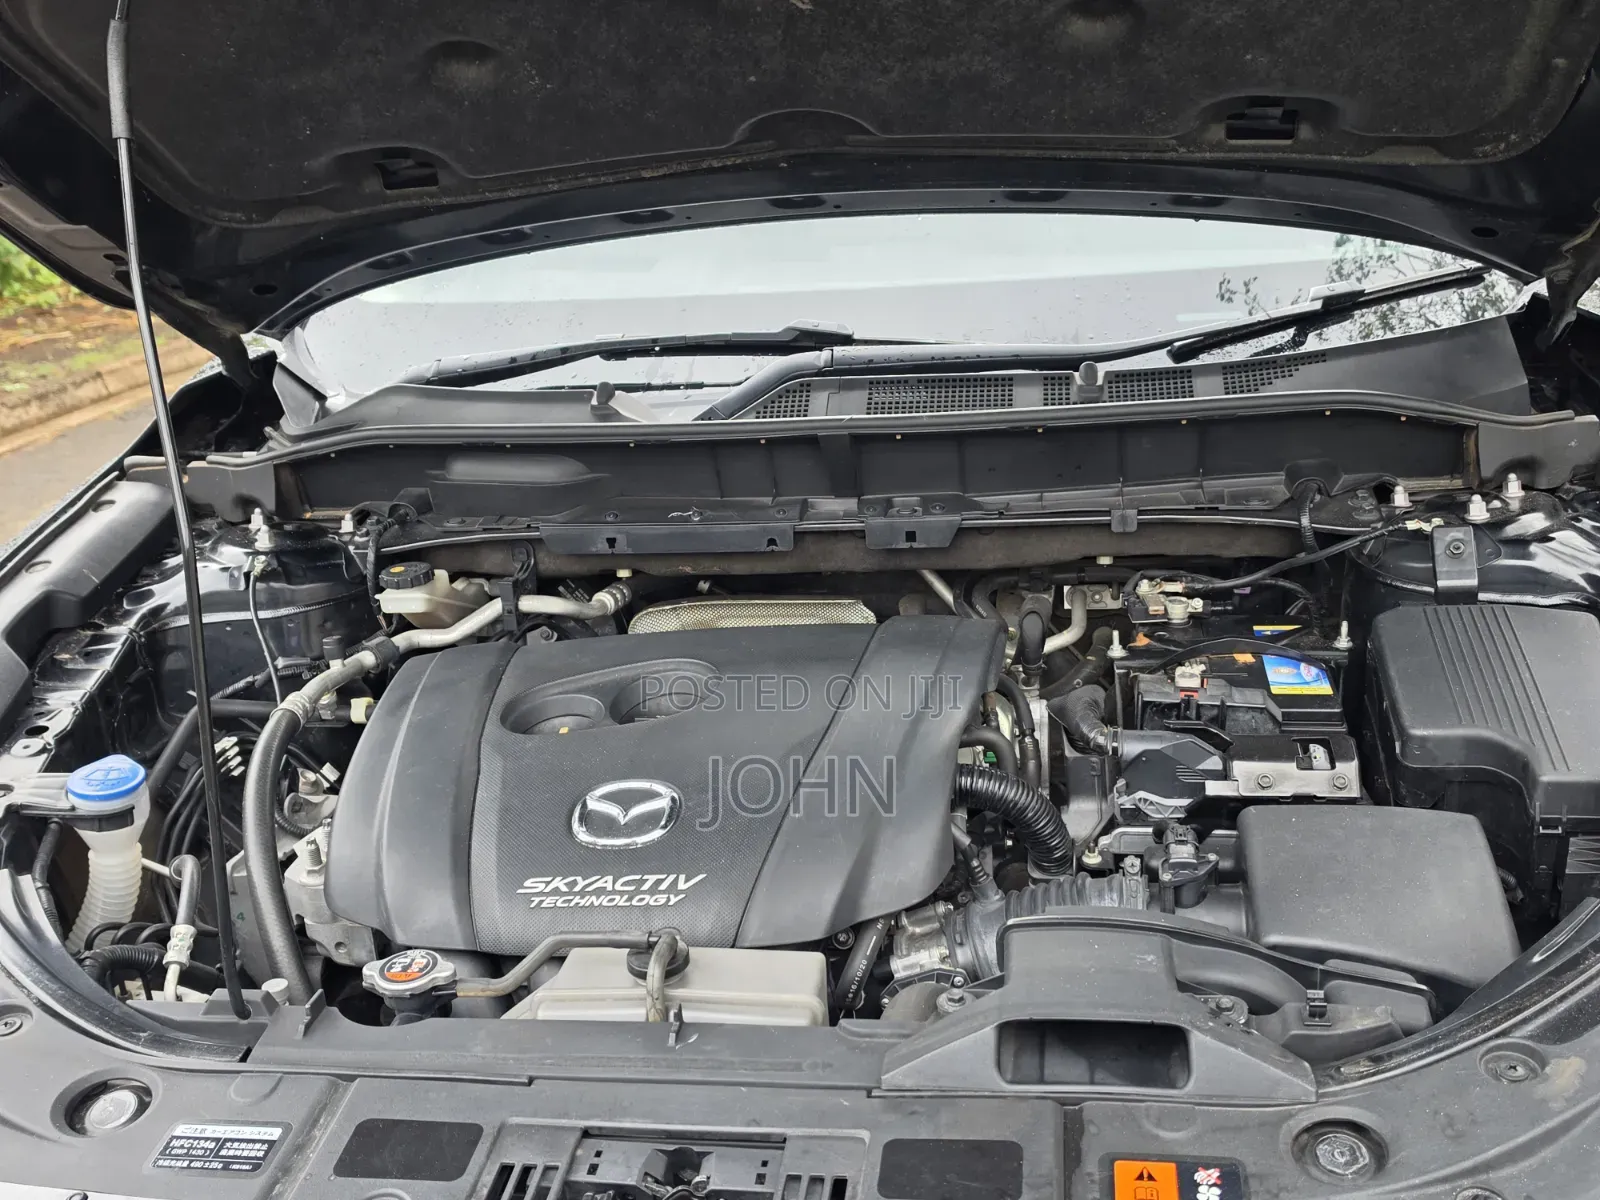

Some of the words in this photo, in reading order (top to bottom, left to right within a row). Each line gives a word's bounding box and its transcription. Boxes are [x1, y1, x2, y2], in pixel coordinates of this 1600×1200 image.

[516, 873, 707, 893] SKYACTIV
[530, 894, 686, 908] TECHNOLOGY
[169, 1138, 217, 1149] HFC134a
